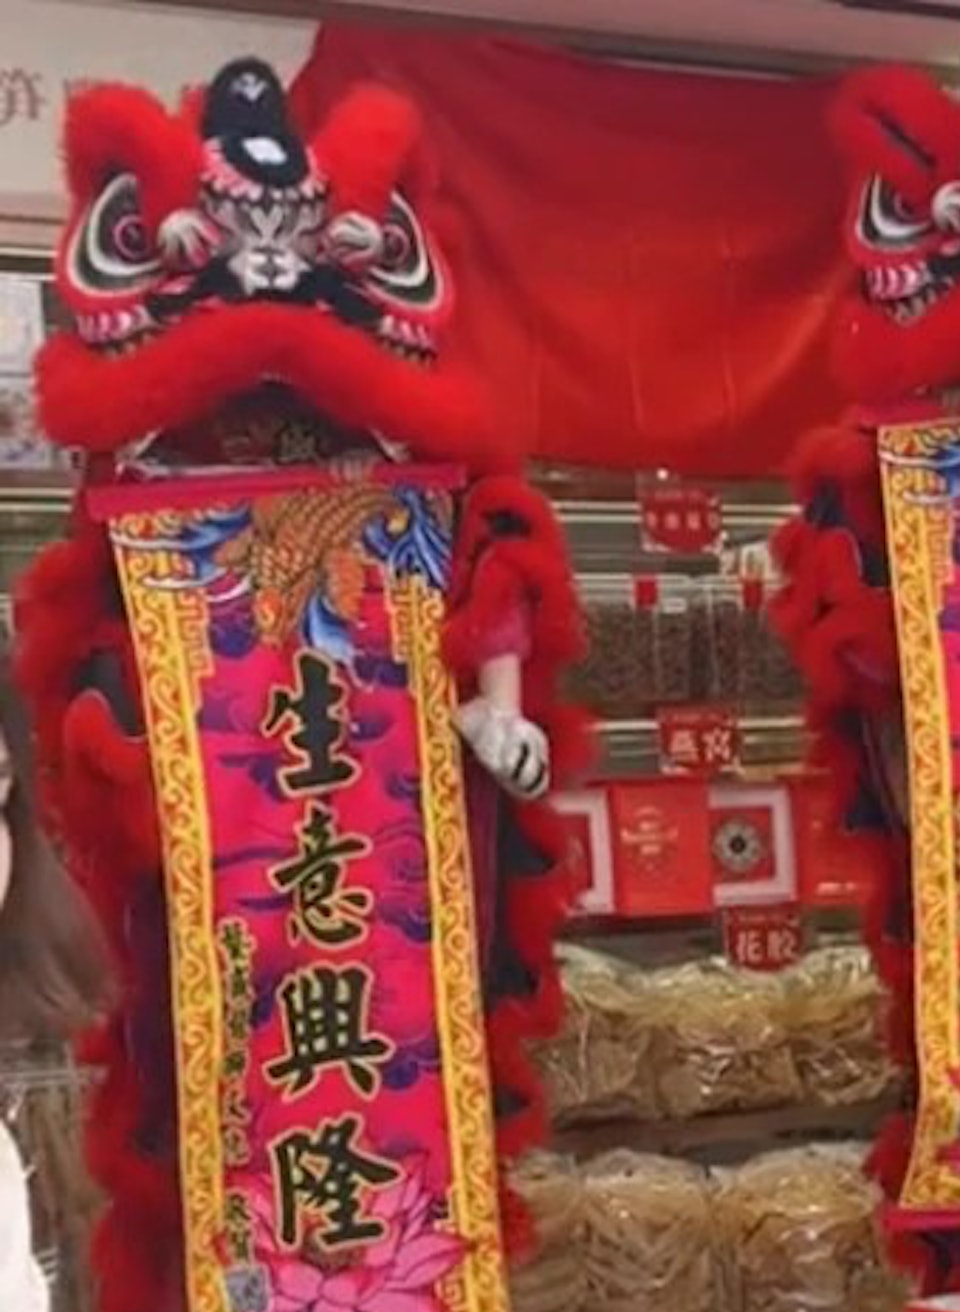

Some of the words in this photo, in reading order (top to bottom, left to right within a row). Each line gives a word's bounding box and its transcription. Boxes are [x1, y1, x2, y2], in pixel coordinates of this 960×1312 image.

[264, 652, 402, 1248] 生意興隆
[736, 928, 799, 962] 花胶
